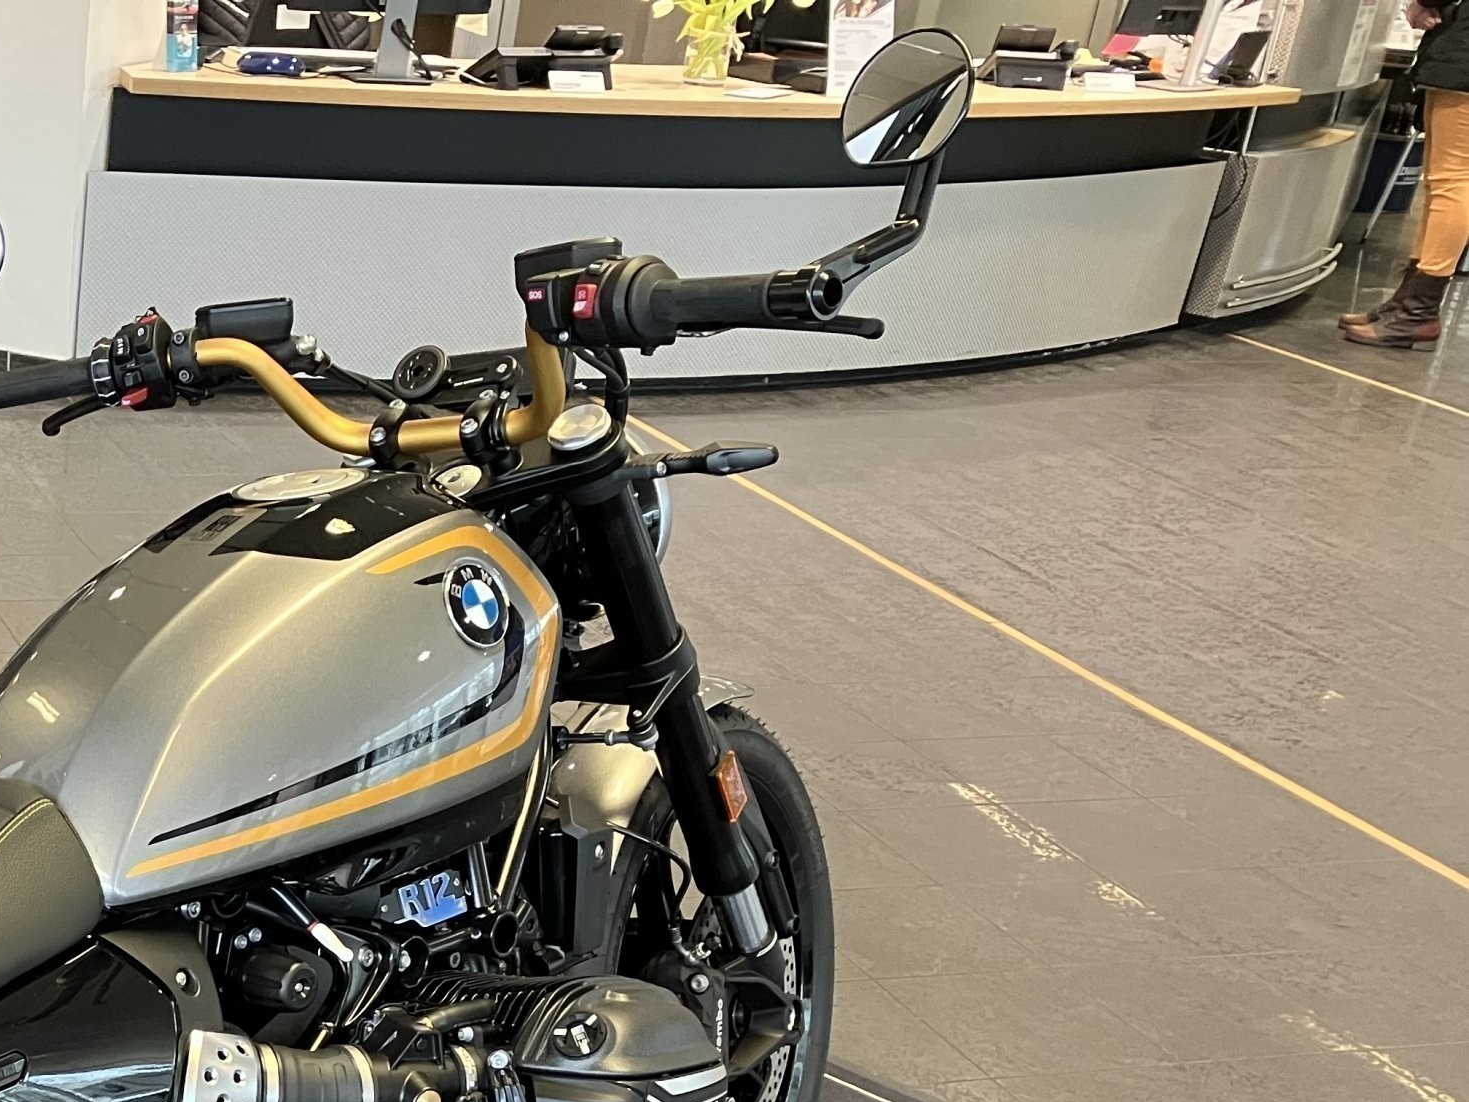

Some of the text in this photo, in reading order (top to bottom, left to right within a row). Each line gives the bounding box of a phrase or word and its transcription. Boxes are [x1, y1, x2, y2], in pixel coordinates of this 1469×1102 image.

[528, 290, 543, 300] SOS
[449, 566, 493, 599] BMW
[398, 872, 455, 919] R12
[715, 998, 724, 1062] rembo
